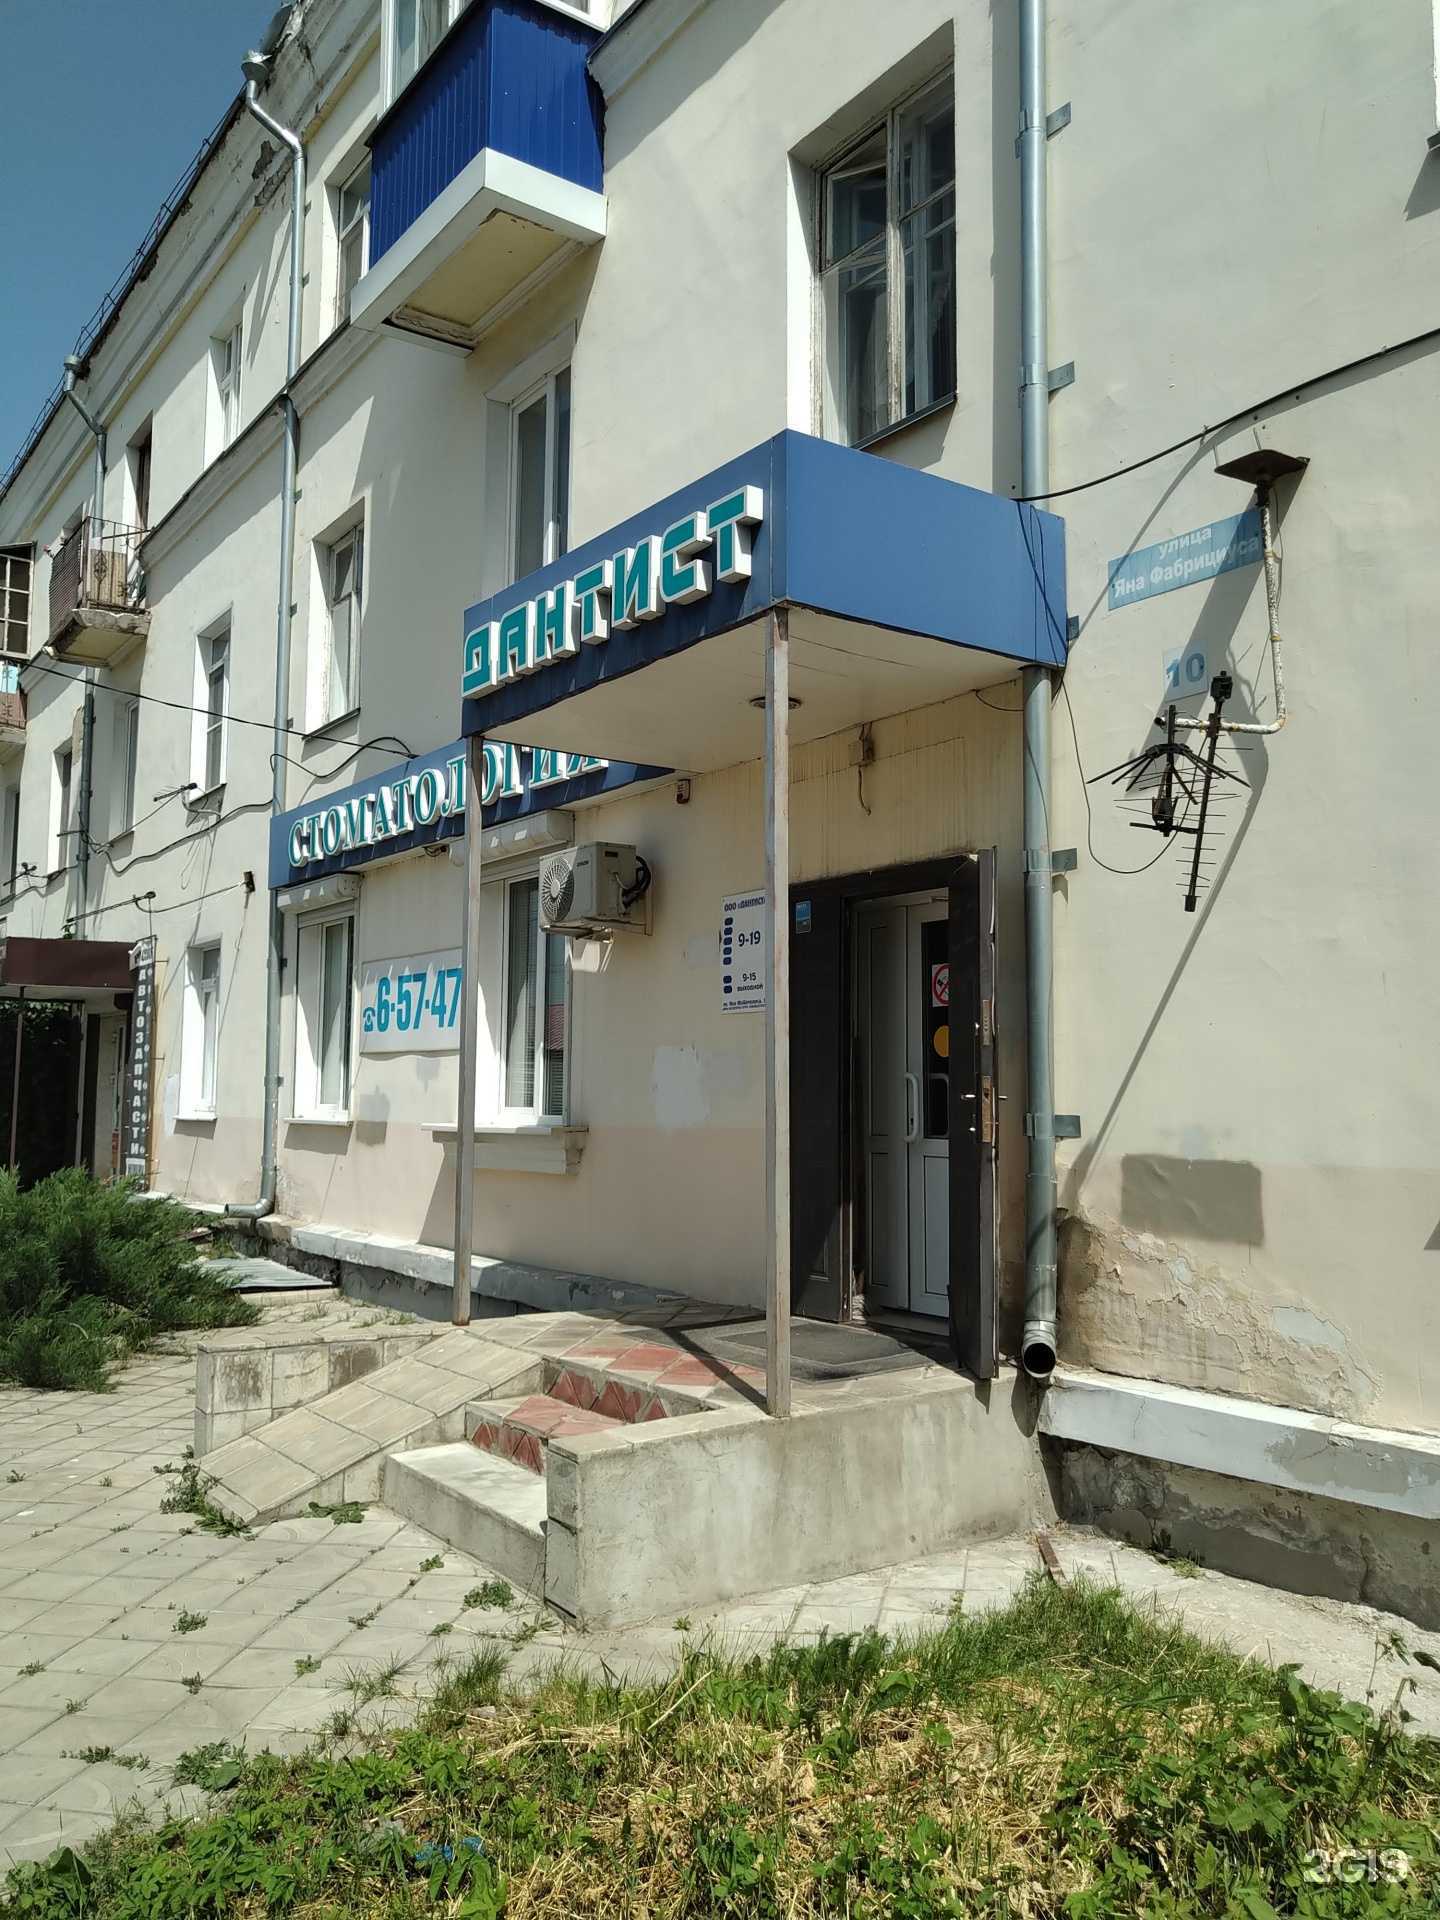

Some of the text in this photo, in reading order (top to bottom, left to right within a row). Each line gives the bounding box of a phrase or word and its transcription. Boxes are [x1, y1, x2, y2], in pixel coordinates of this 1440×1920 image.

[1159, 527, 1212, 559] улица
[1114, 536, 1259, 599] Яна Фабрициуса
[462, 485, 764, 700] ДАНТИСТ
[1166, 652, 1206, 689] 10
[738, 930, 761, 948] 9-19
[742, 972, 757, 982] 9-15
[130, 968, 147, 1155] АВТОЗАПЧАСТИ
